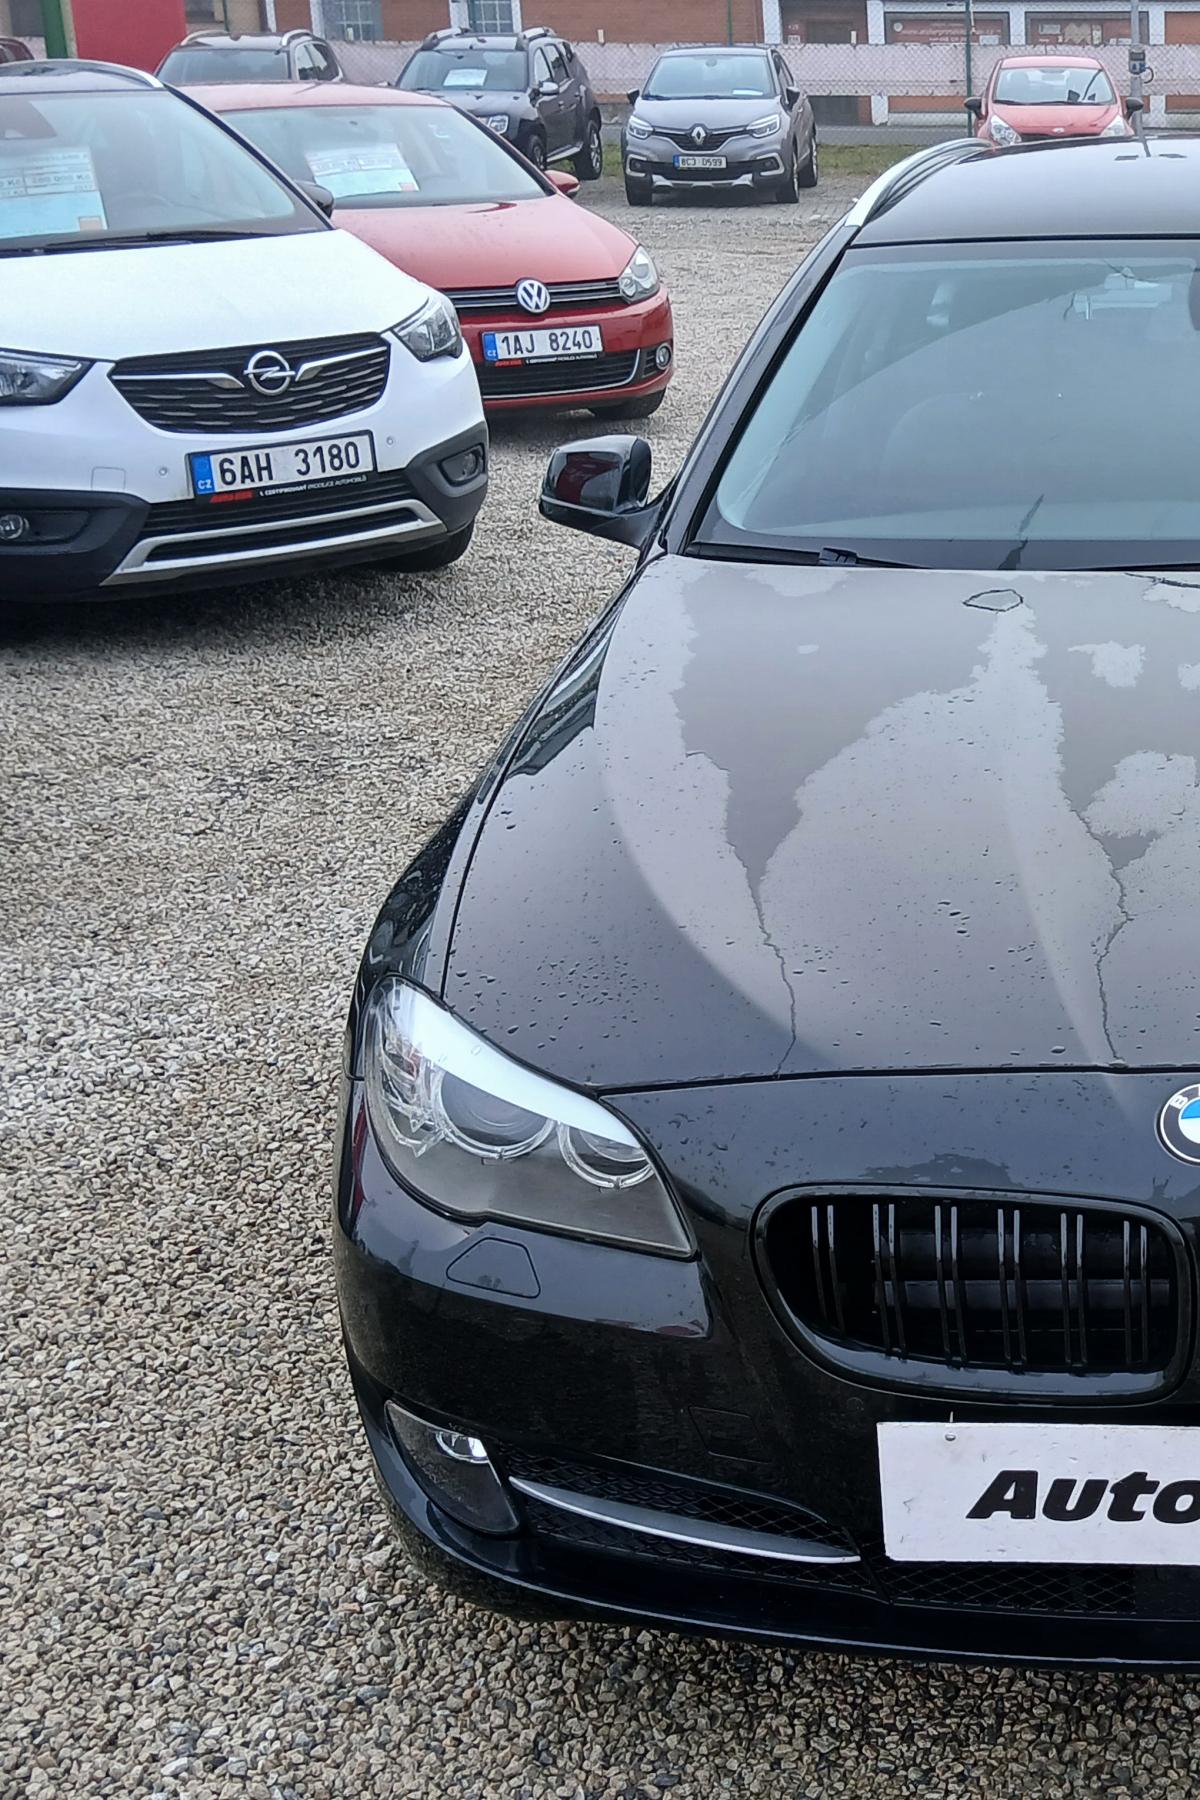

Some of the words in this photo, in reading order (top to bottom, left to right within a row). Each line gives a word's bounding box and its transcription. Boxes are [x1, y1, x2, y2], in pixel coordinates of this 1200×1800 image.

[501, 334, 536, 356] 1AJ
[548, 330, 593, 352] 8240
[218, 452, 274, 486] 6AH
[294, 440, 361, 476] 3180
[198, 480, 212, 490] CZ
